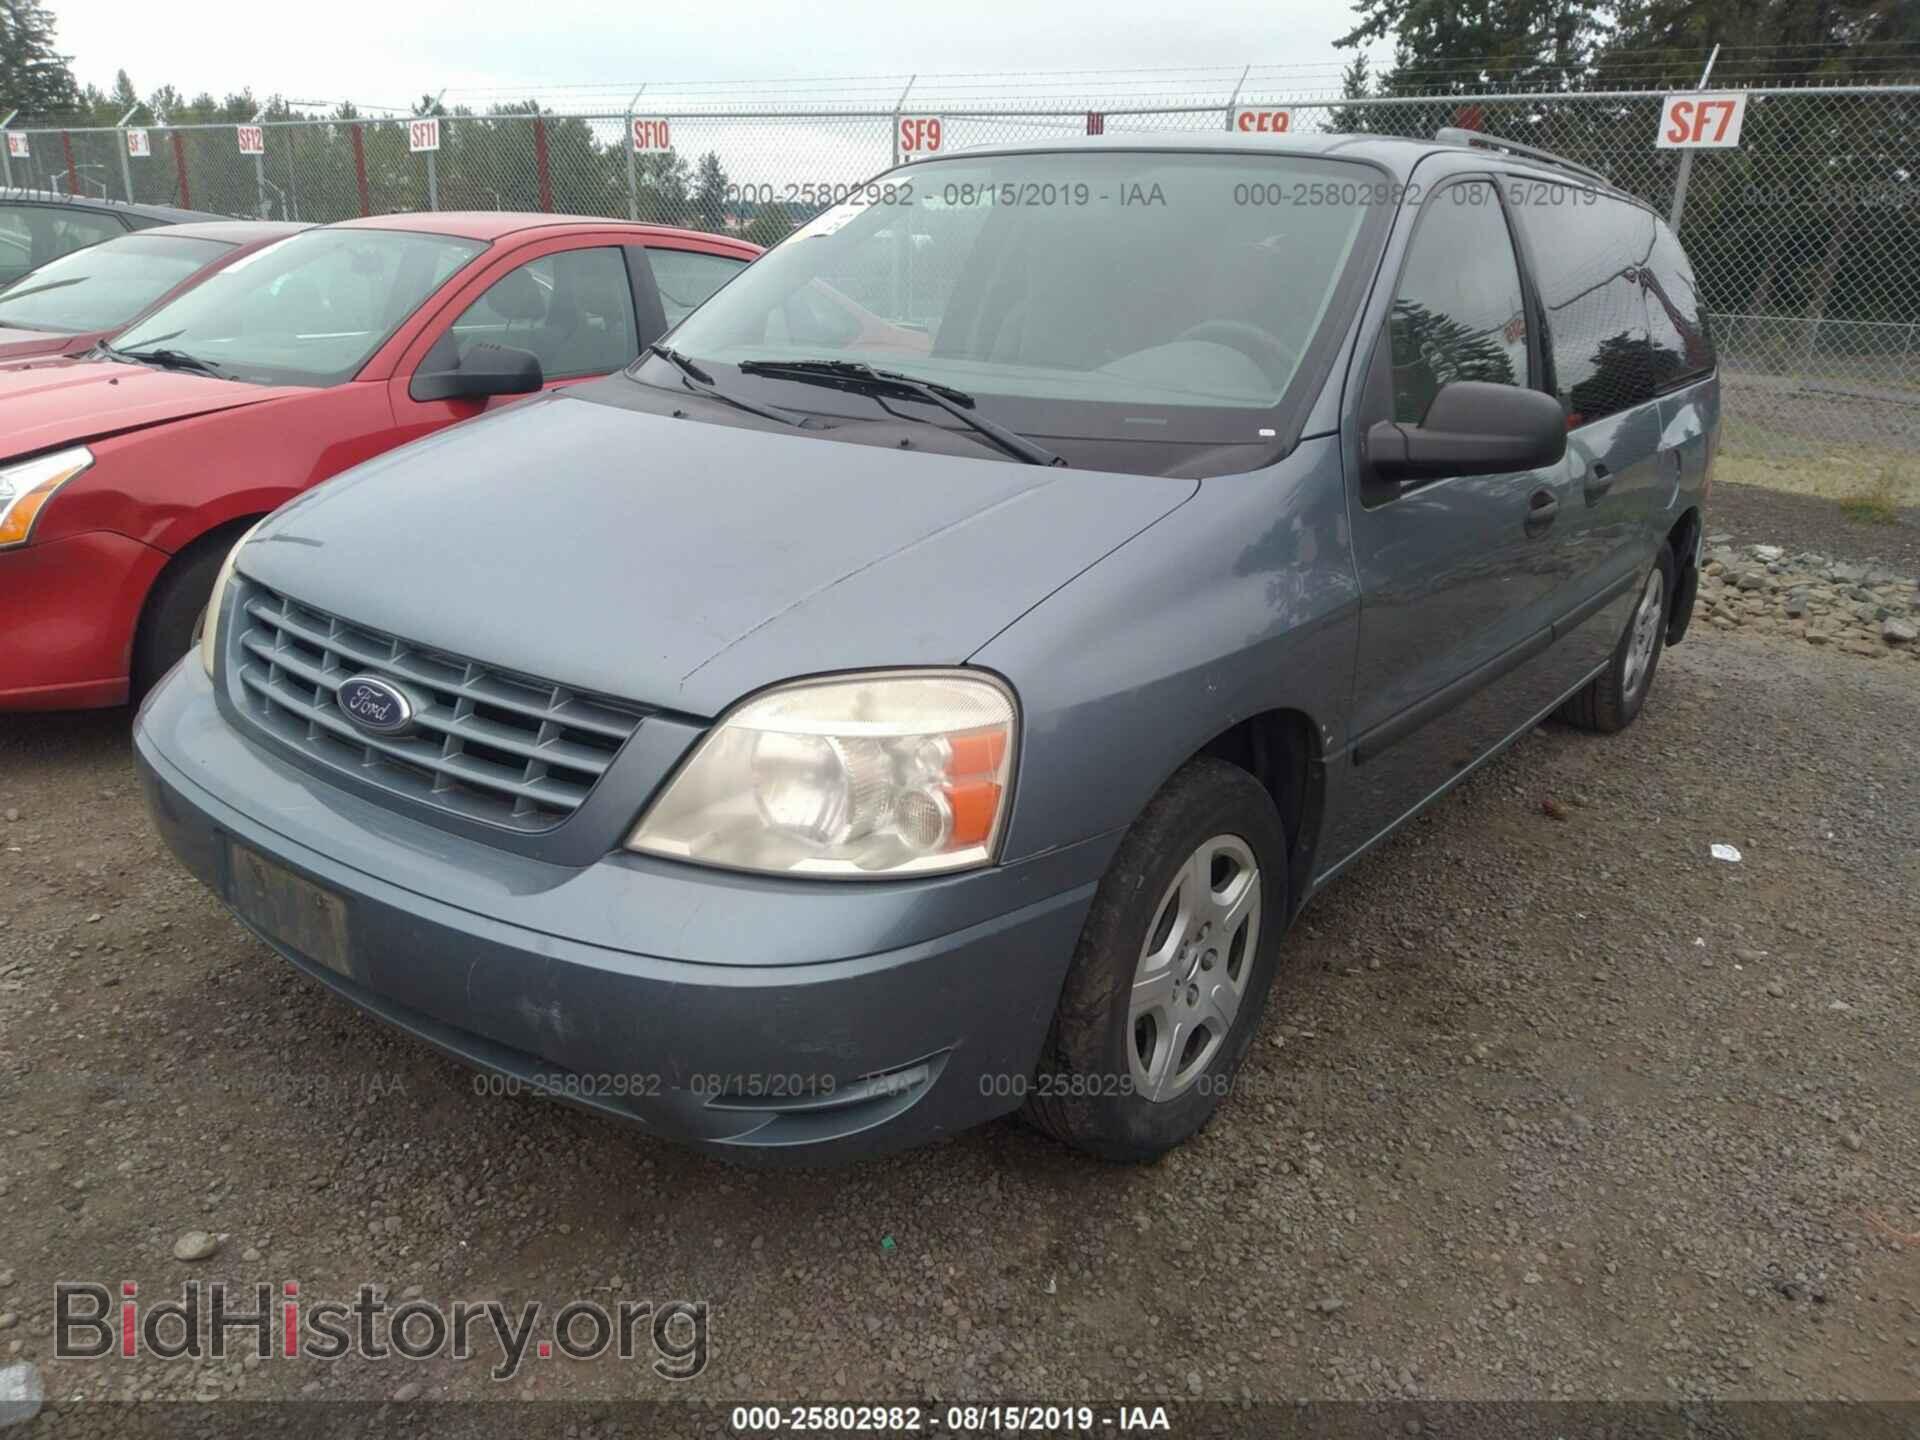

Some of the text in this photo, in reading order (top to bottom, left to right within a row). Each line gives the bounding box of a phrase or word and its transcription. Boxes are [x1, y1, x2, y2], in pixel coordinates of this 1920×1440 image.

[413, 122, 436, 147] SF11
[635, 120, 668, 148] SF10
[901, 119, 941, 151] SF9
[1667, 100, 1736, 143] SF7
[239, 127, 263, 150] SF12
[350, 685, 391, 720] Ford
